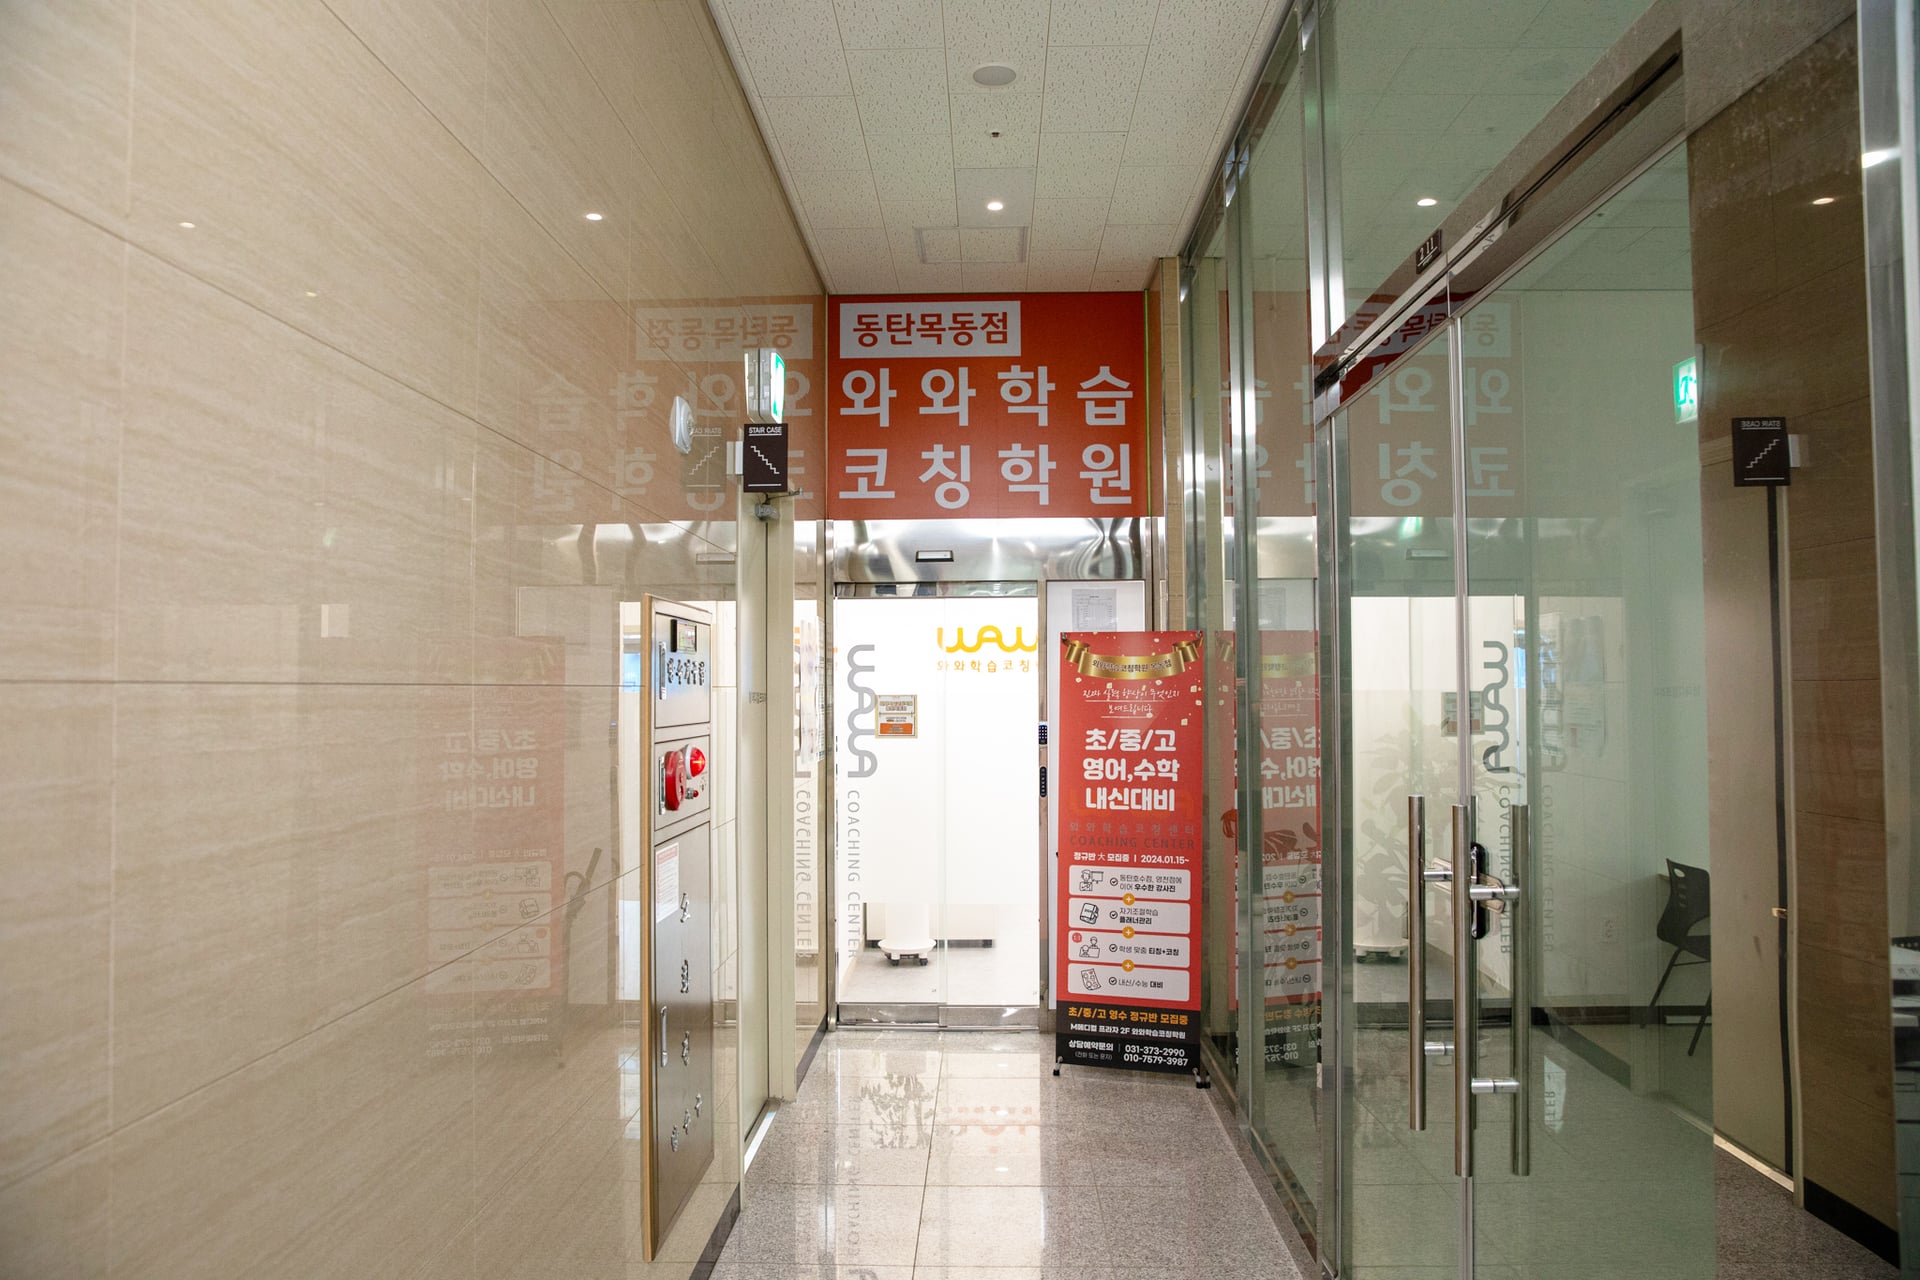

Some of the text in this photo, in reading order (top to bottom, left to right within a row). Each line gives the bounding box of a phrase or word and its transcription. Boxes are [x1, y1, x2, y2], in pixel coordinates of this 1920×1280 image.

[853, 312, 1008, 347] 동탄목동점
[1085, 728, 1177, 751] 초/중/고
[1082, 758, 1180, 782] 영어,수학
[1085, 787, 1176, 811] 내신대비
[1069, 835, 1195, 850] COACHING CENTER
[1074, 852, 1096, 861] 정규반
[1107, 853, 1130, 863] 모집중
[1141, 855, 1190, 865] 2024.01.15~
[847, 790, 861, 960] COACHING CENTER
[1134, 883, 1154, 892] 우수한
[1156, 885, 1176, 893] 강사진
[1120, 916, 1152, 925] 플래너관리
[1149, 981, 1164, 989] 대비
[1068, 1007, 1189, 1026] 초/중/고 영수 정규반 모집중
[1099, 1025, 1119, 1034] 프라자
[1068, 1040, 1114, 1052] 상담예약문의
[1125, 1044, 1185, 1057] 031-373-2990
[1123, 1054, 1189, 1067] 010-7579-3987
